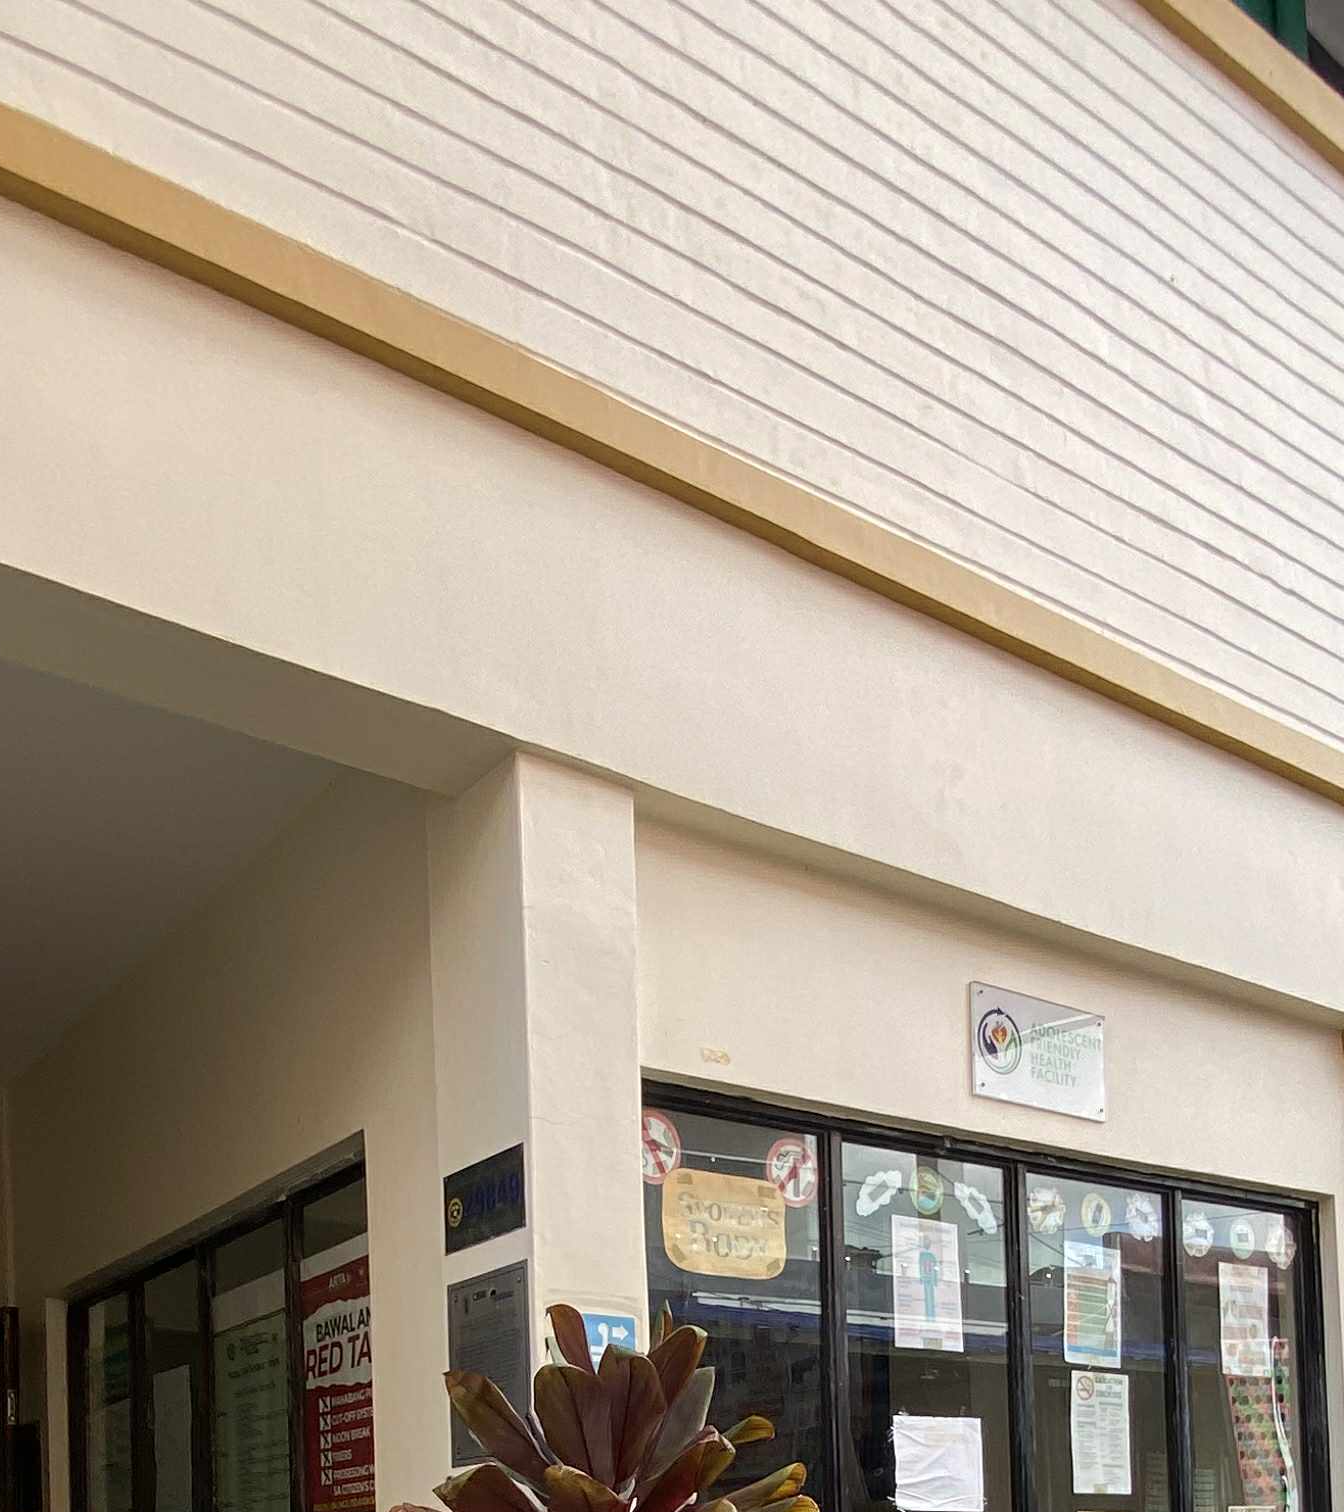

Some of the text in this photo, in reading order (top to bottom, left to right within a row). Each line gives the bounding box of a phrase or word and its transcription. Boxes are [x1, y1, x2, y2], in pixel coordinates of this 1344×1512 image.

[1030, 1053, 1072, 1073] HEALTH
[1030, 1067, 1078, 1088] FACILITY
[316, 1306, 371, 1342] BAWAL AN
[306, 1331, 372, 1380] RED TA
